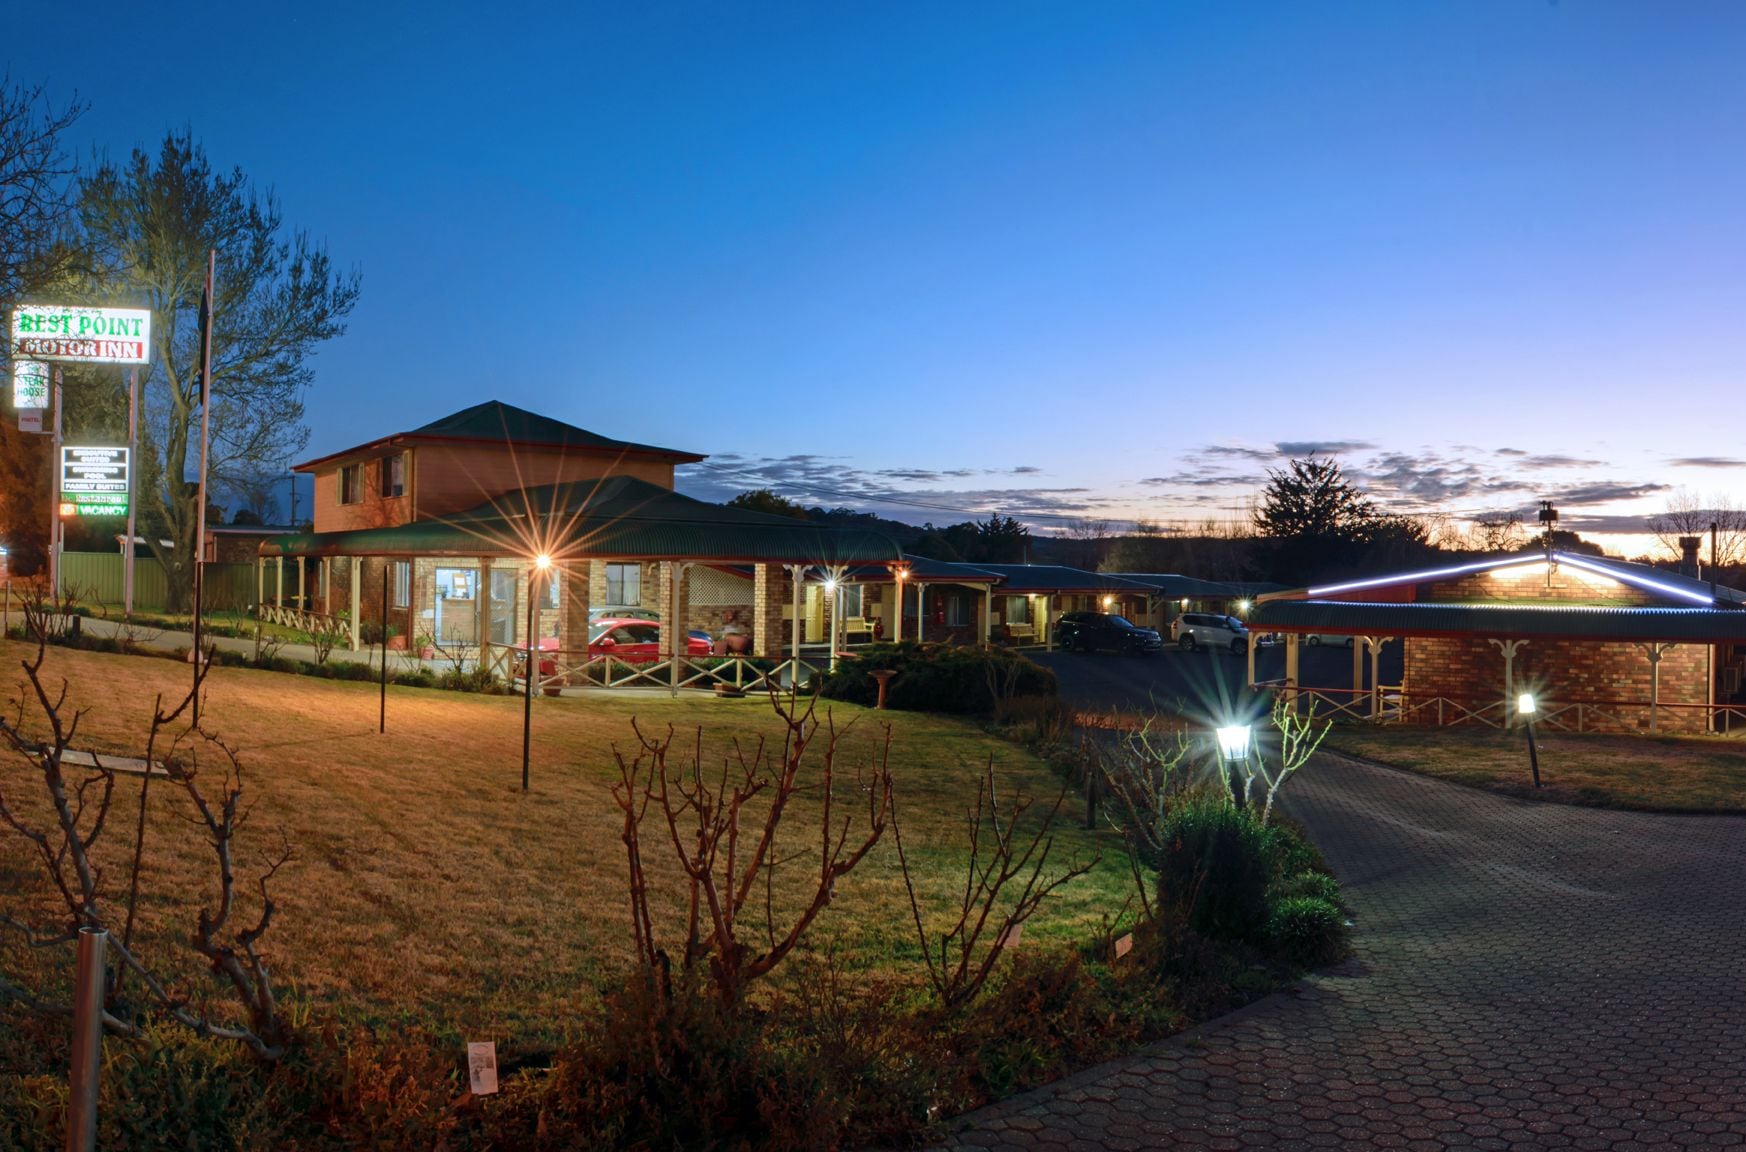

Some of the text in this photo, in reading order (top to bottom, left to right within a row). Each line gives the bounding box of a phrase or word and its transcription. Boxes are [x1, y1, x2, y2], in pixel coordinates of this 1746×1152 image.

[19, 313, 144, 336] REST POINT
[25, 338, 138, 358] MOTOR INN
[80, 505, 127, 516] VACANCY
